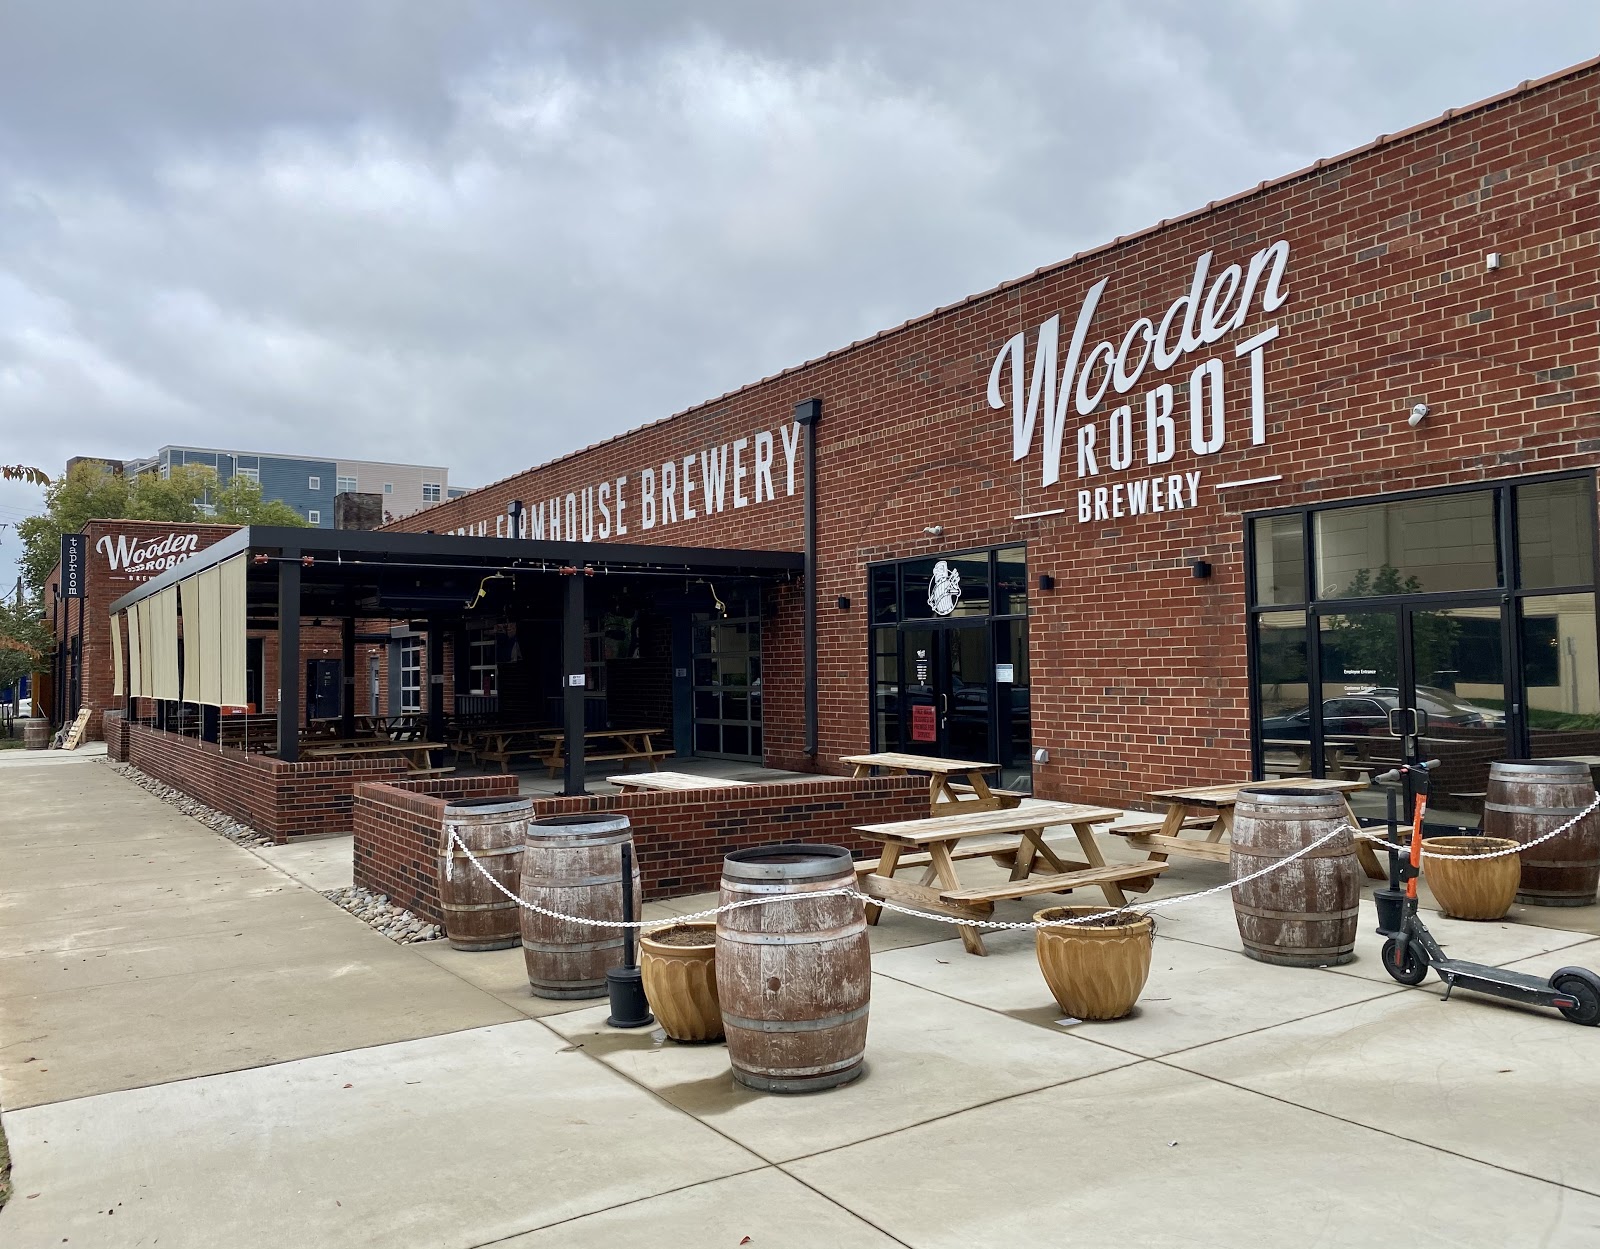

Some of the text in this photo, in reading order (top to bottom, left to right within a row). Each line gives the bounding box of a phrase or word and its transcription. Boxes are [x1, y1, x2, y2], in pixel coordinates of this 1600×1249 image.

[987, 239, 1291, 488] Wooden
[1077, 324, 1280, 478] ROBOT
[641, 421, 801, 530] BREWERY
[1078, 471, 1202, 523] BREWERY
[68, 537, 78, 595] taproom
[96, 533, 199, 571] Wooden
[145, 552, 199, 571] ROBO
